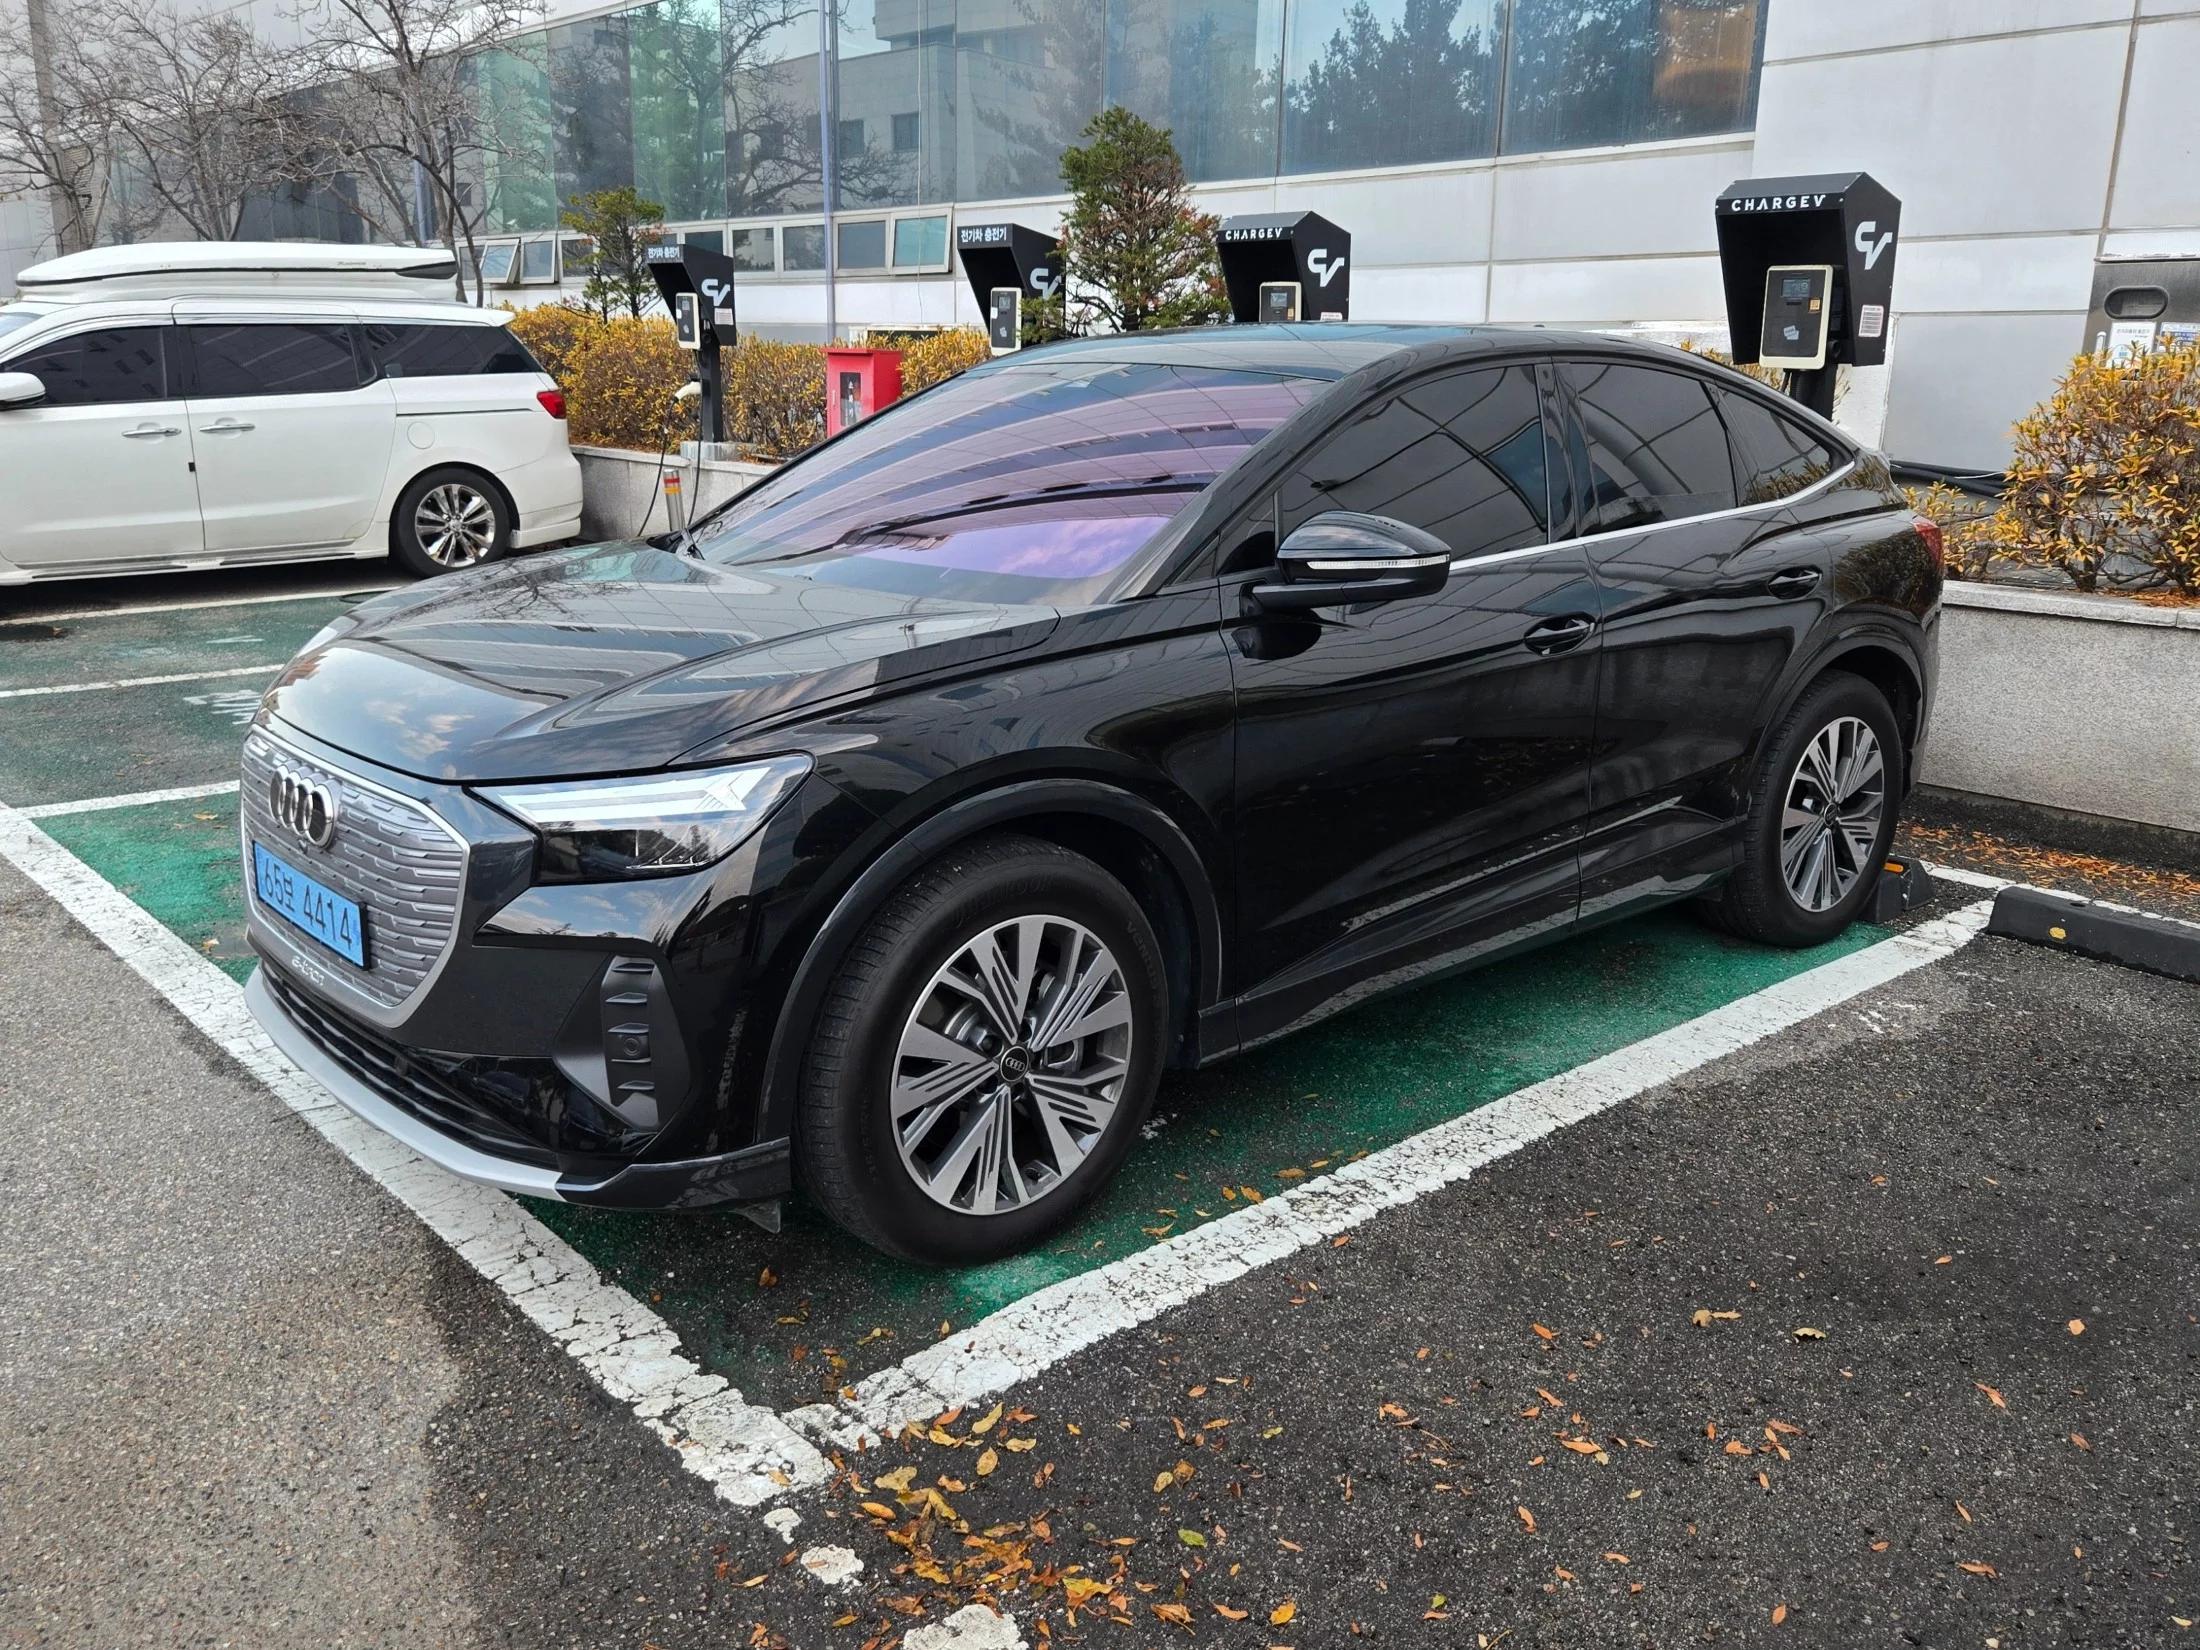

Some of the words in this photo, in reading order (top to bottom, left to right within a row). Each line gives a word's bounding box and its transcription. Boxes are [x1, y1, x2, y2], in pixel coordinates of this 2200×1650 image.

[1731, 195, 1826, 212] CHARGEV
[961, 229, 983, 242] 전기차
[984, 227, 1006, 242] 충전기
[1225, 228, 1282, 240] CHARGEV
[264, 858, 295, 912] 65보
[304, 885, 353, 950] 4414
